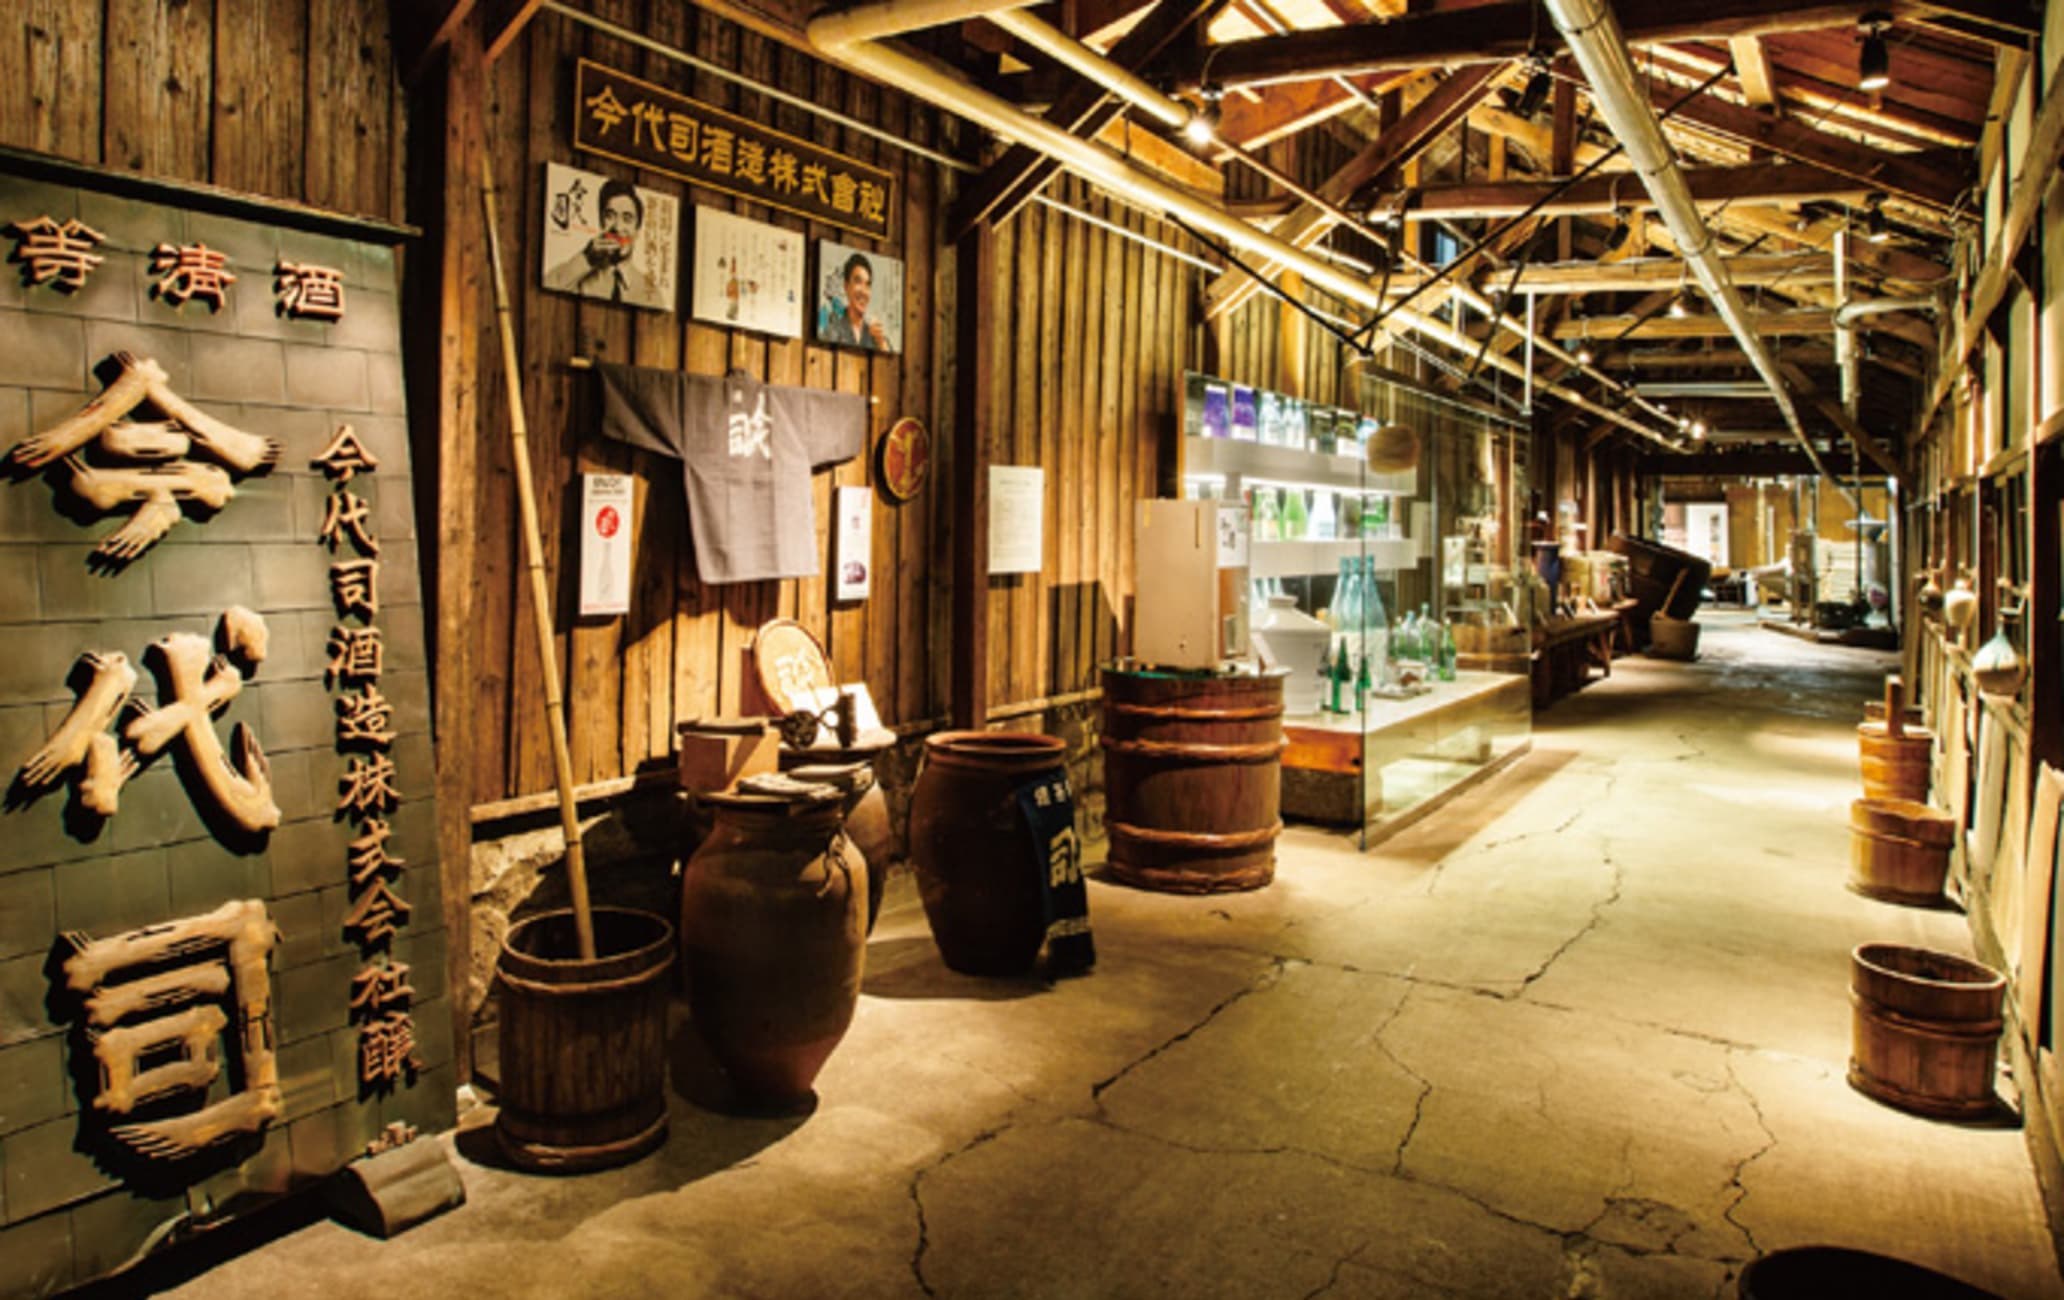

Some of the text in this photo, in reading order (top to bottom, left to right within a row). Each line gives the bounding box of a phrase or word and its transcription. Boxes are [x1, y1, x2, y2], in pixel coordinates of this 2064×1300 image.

[586, 85, 885, 223] 今代司酒造株式會社
[10, 350, 283, 1162] 今代司
